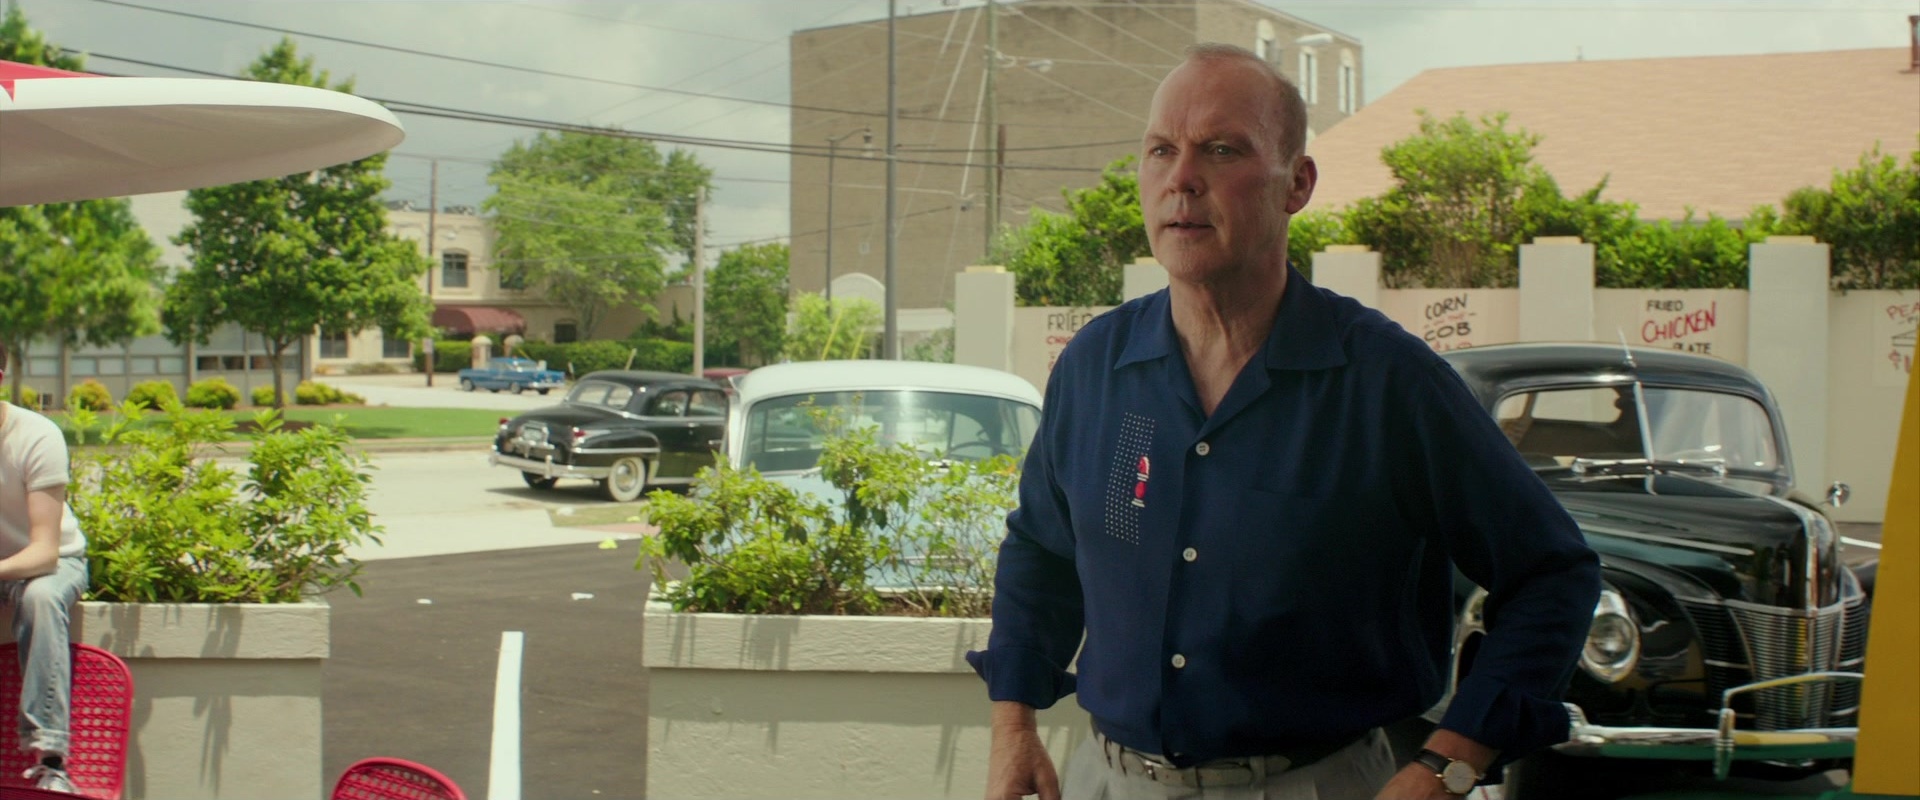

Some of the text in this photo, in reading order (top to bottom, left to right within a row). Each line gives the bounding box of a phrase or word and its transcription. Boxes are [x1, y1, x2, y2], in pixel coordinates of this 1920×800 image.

[1425, 292, 1468, 320] CORN
[1646, 299, 1684, 312] FRIED
[1424, 321, 1471, 342] COB
[1642, 300, 1716, 343] CHICKEN
